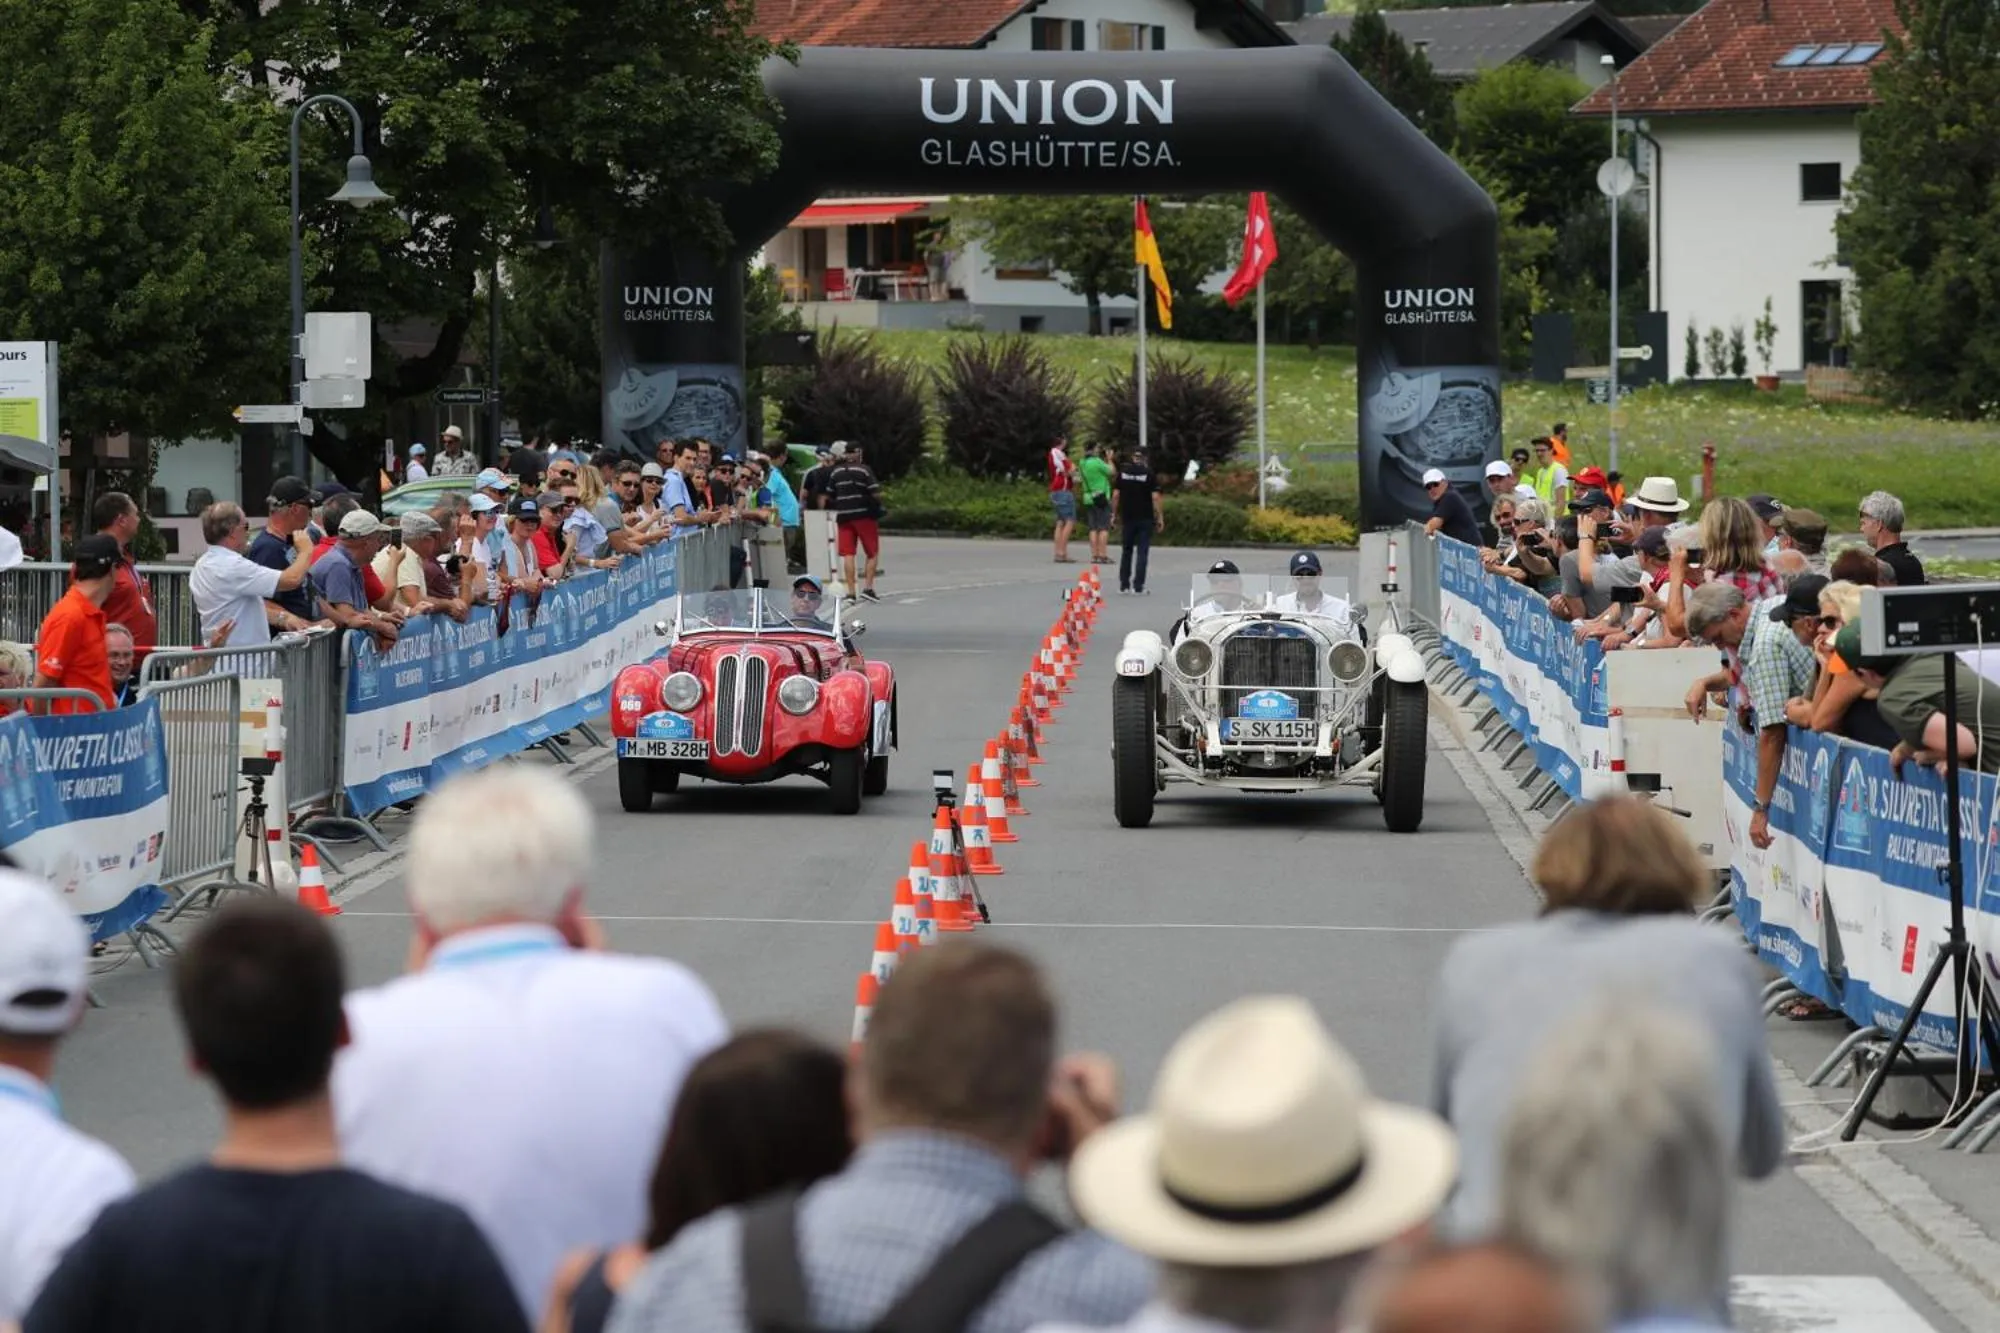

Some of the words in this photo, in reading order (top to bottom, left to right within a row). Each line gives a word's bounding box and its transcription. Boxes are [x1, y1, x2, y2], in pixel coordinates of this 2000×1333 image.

[919, 77, 1177, 126] UNION
[920, 134, 1182, 167] GLASHÜTTE/SA.
[624, 286, 714, 305] UNION
[1384, 288, 1475, 308] UNION
[1231, 722, 1241, 737] S
[1251, 722, 1271, 737] SK
[1275, 723, 1316, 738] 115H
[627, 741, 637, 755] M
[647, 741, 667, 756] MB
[670, 742, 708, 757] 328H
[1881, 780, 1940, 833] SILVRETTA
[1941, 792, 1985, 844] CSSIC
